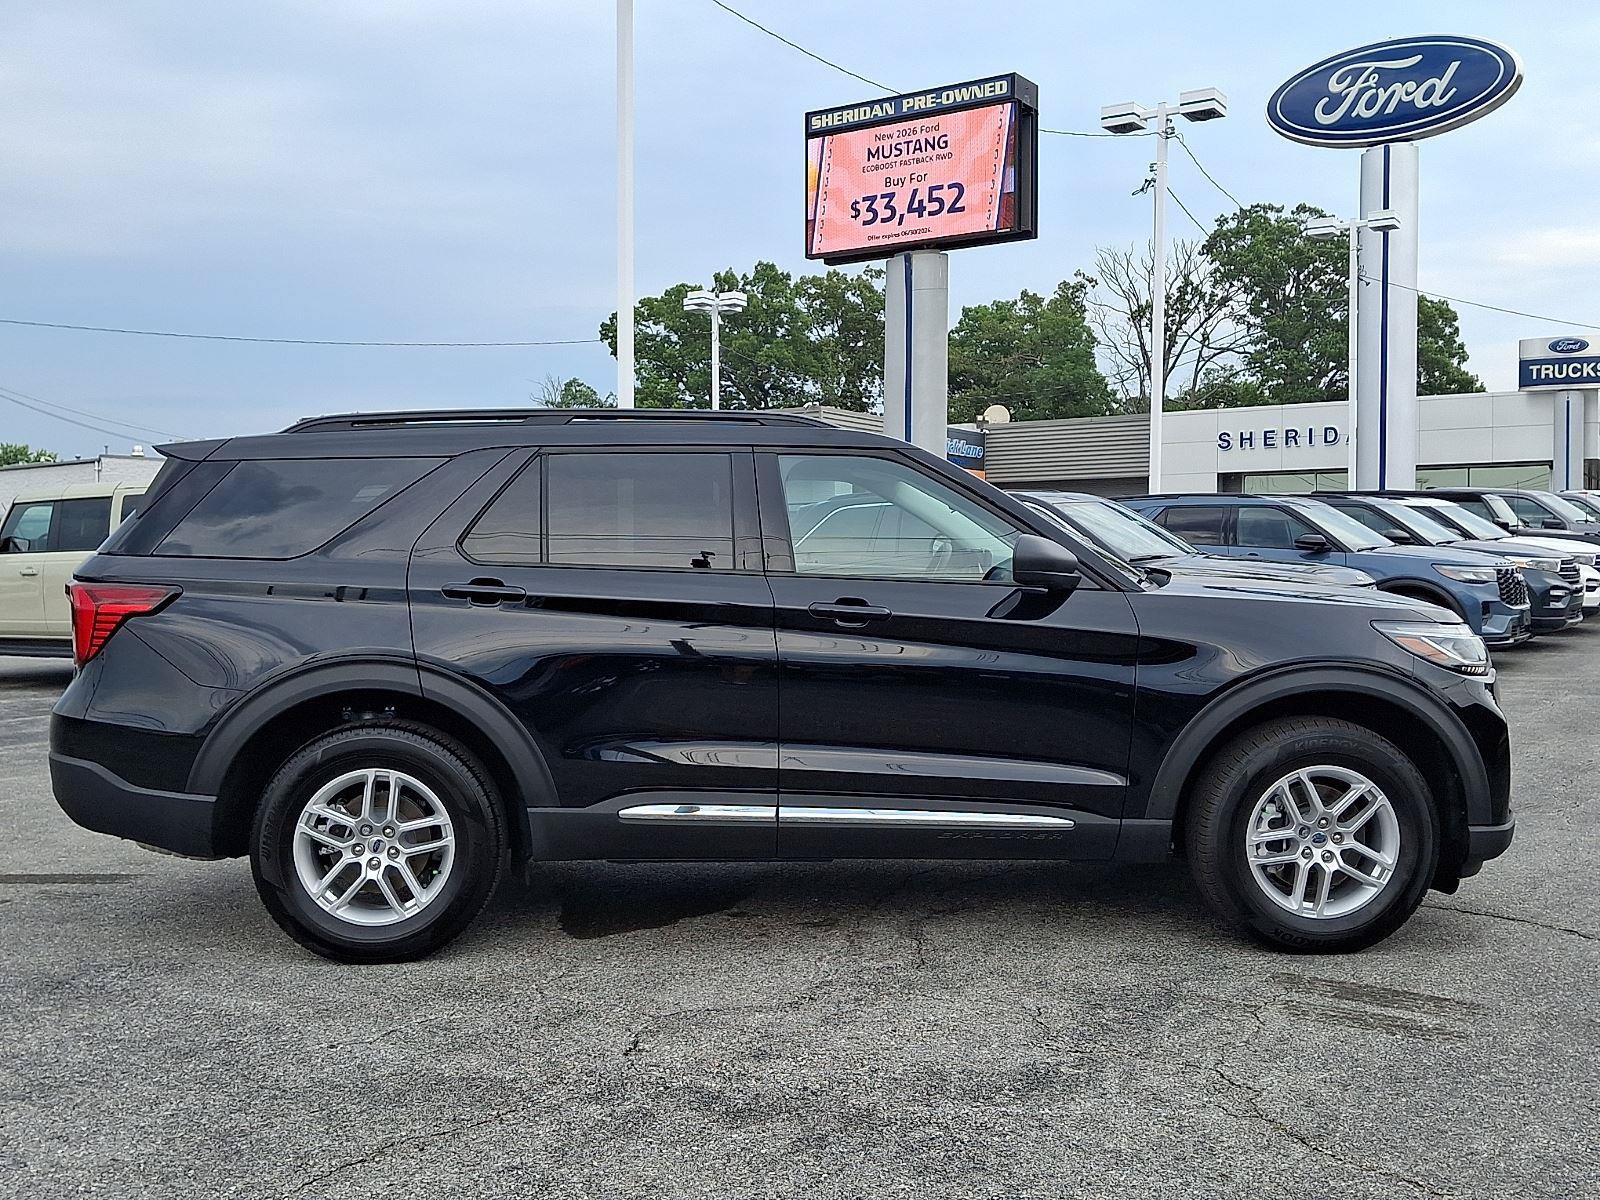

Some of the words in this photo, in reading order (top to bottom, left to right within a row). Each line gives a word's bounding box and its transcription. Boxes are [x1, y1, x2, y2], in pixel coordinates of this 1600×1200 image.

[1314, 53, 1462, 125] Ford
[811, 102, 895, 130] SHERIDAN
[901, 80, 1008, 112] PRE-OWNED
[874, 131, 894, 142] New
[896, 127, 918, 139] 2026
[920, 122, 940, 135] Ford
[867, 134, 949, 162] MUSTANG
[862, 161, 898, 174] ECOBOOST
[899, 155, 934, 168] FASTBACK
[935, 152, 953, 163] RWD
[884, 175, 906, 189] Buy
[909, 172, 928, 184] For
[850, 182, 966, 227] $33,452
[882, 232, 900, 240] expires
[1556, 340, 1581, 351] Ford
[1217, 425, 1349, 451] SHERID
